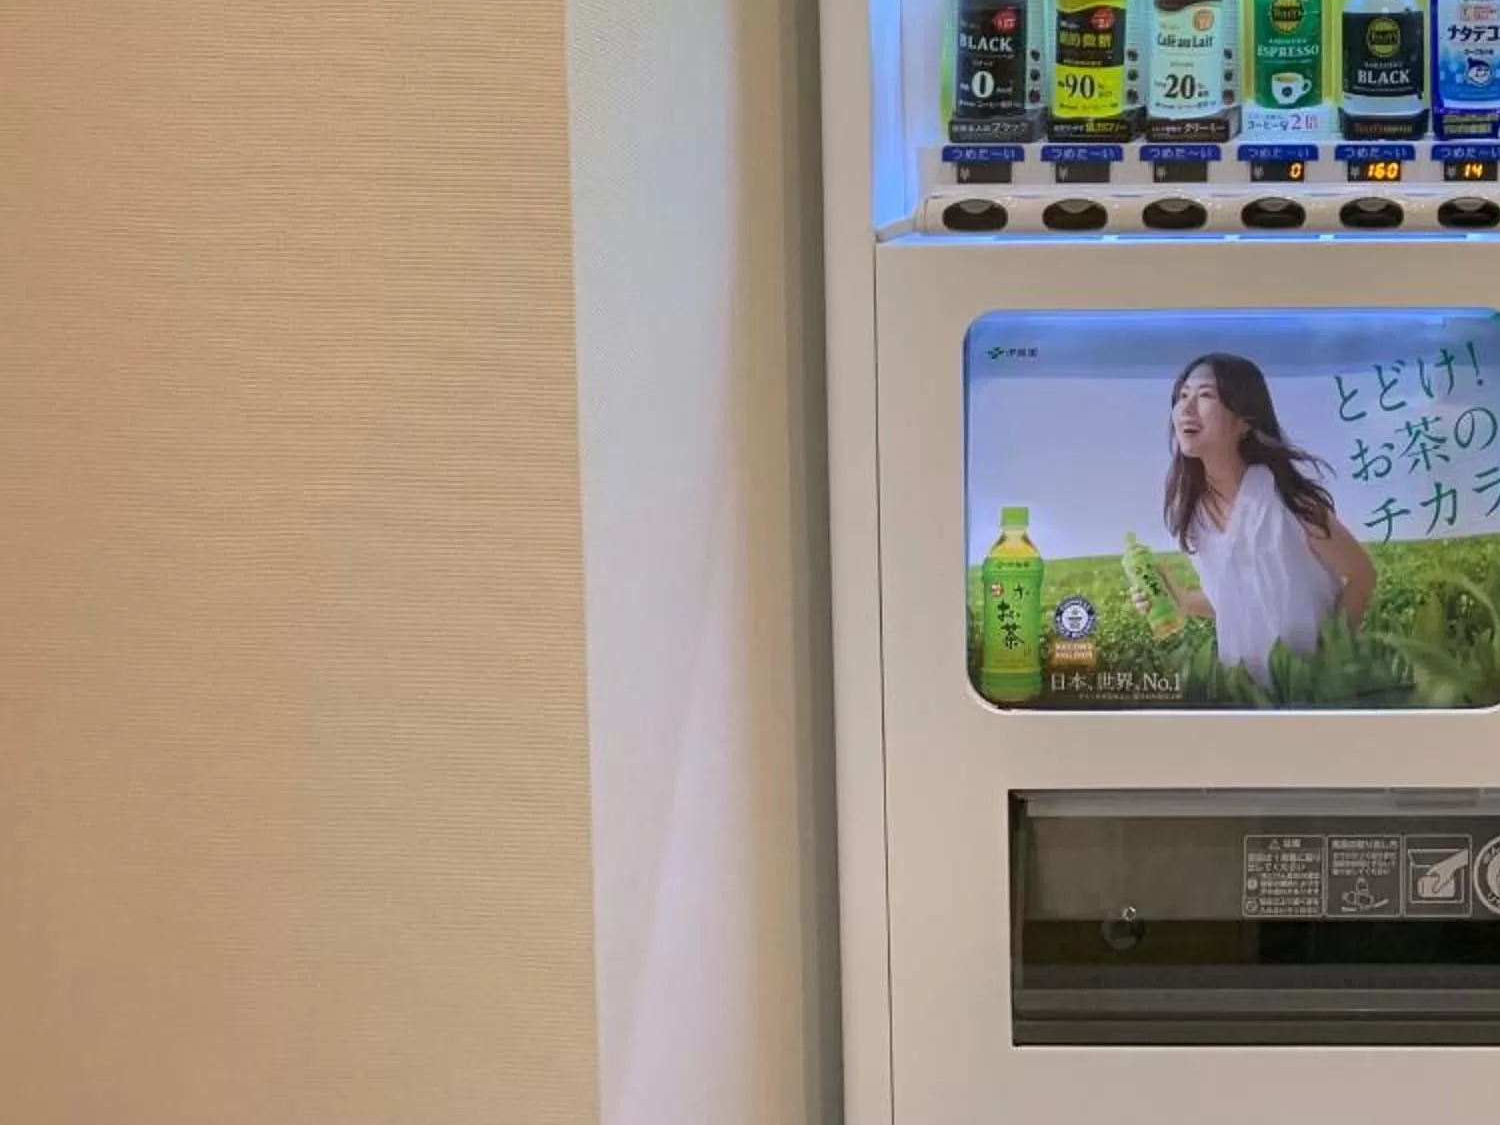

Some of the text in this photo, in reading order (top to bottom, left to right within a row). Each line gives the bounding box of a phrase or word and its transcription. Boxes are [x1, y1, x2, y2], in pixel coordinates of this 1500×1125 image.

[959, 32, 1013, 52] BLACK
[1193, 32, 1214, 48] Lait
[1257, 43, 1319, 58] ESPRESSO
[971, 70, 995, 98] 0
[1356, 68, 1411, 85] BLACK
[1065, 74, 1095, 99] 90
[1163, 73, 1196, 99] 20
[1290, 162, 1301, 179] 0
[1368, 162, 1399, 179] 160
[1463, 162, 1484, 178] 14
[1350, 406, 1498, 481] お茶の
[997, 599, 1025, 650] お茶
